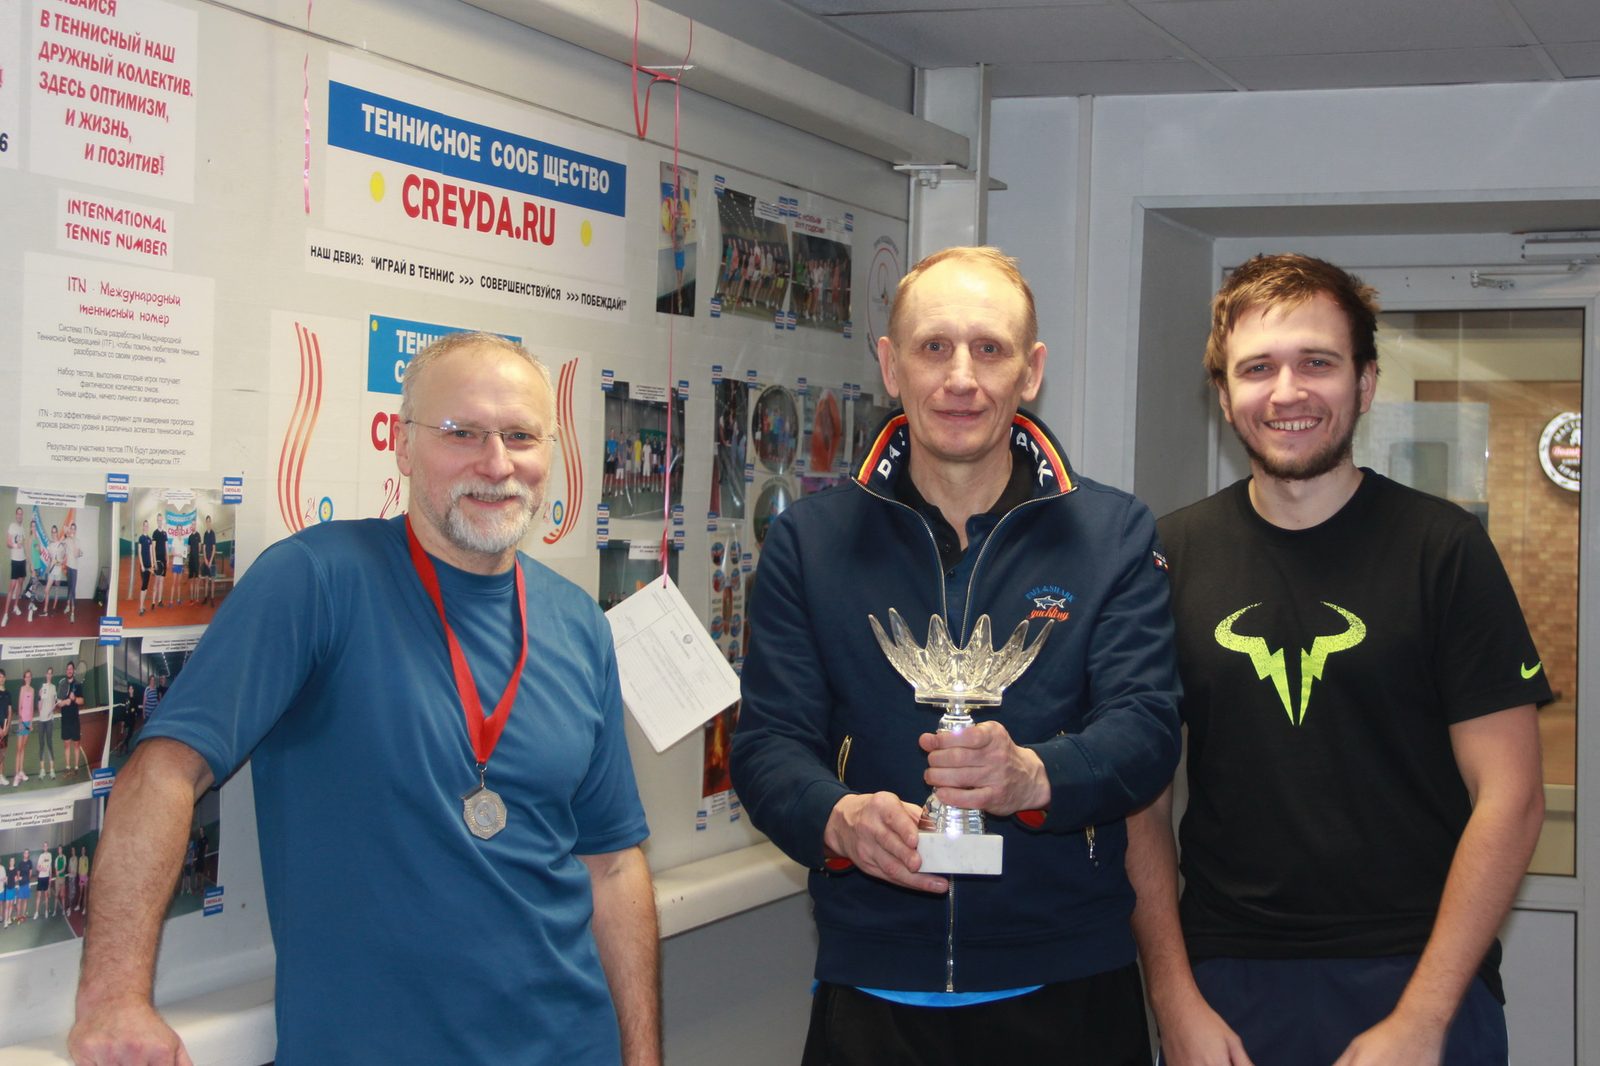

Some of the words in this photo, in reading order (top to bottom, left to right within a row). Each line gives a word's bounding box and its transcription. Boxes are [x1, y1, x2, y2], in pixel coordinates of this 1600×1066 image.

[40, 9, 50, 28] В
[54, 13, 141, 52] ТЕННИСНЫЙ
[144, 39, 176, 63] НАШ
[38, 41, 113, 74] ДРУЖНЫЙ
[117, 61, 193, 97] КОЛЛЕКТИВ.
[38, 71, 86, 98] ЗДЕСЬ
[90, 84, 169, 122] ОПТИМИЗМ,
[64, 108, 75, 126] И
[79, 111, 132, 143] ЖИЗНЬ,
[361, 103, 481, 162] ТЕННИСНОЕ
[84, 142, 95, 160] И
[98, 145, 165, 176] ПОЗИТИВ!
[66, 198, 167, 233] INTERNATIONAL
[401, 173, 556, 246] CREYDA.RU
[64, 222, 111, 246] TENNIS
[116, 232, 168, 256] NUMBER
[67, 275, 87, 293] ITN
[100, 281, 181, 306] Международный
[310, 246, 331, 260] НАШ
[333, 249, 364, 266] ДЕВИЗ:
[409, 264, 416, 276] В
[418, 266, 454, 284] ТЕННИС
[480, 275, 561, 301] СОВЕРШЕНСТВУЙСЯ
[79, 304, 134, 321] теннисный
[139, 311, 170, 327] номер
[1027, 606, 1071, 622] yachting
